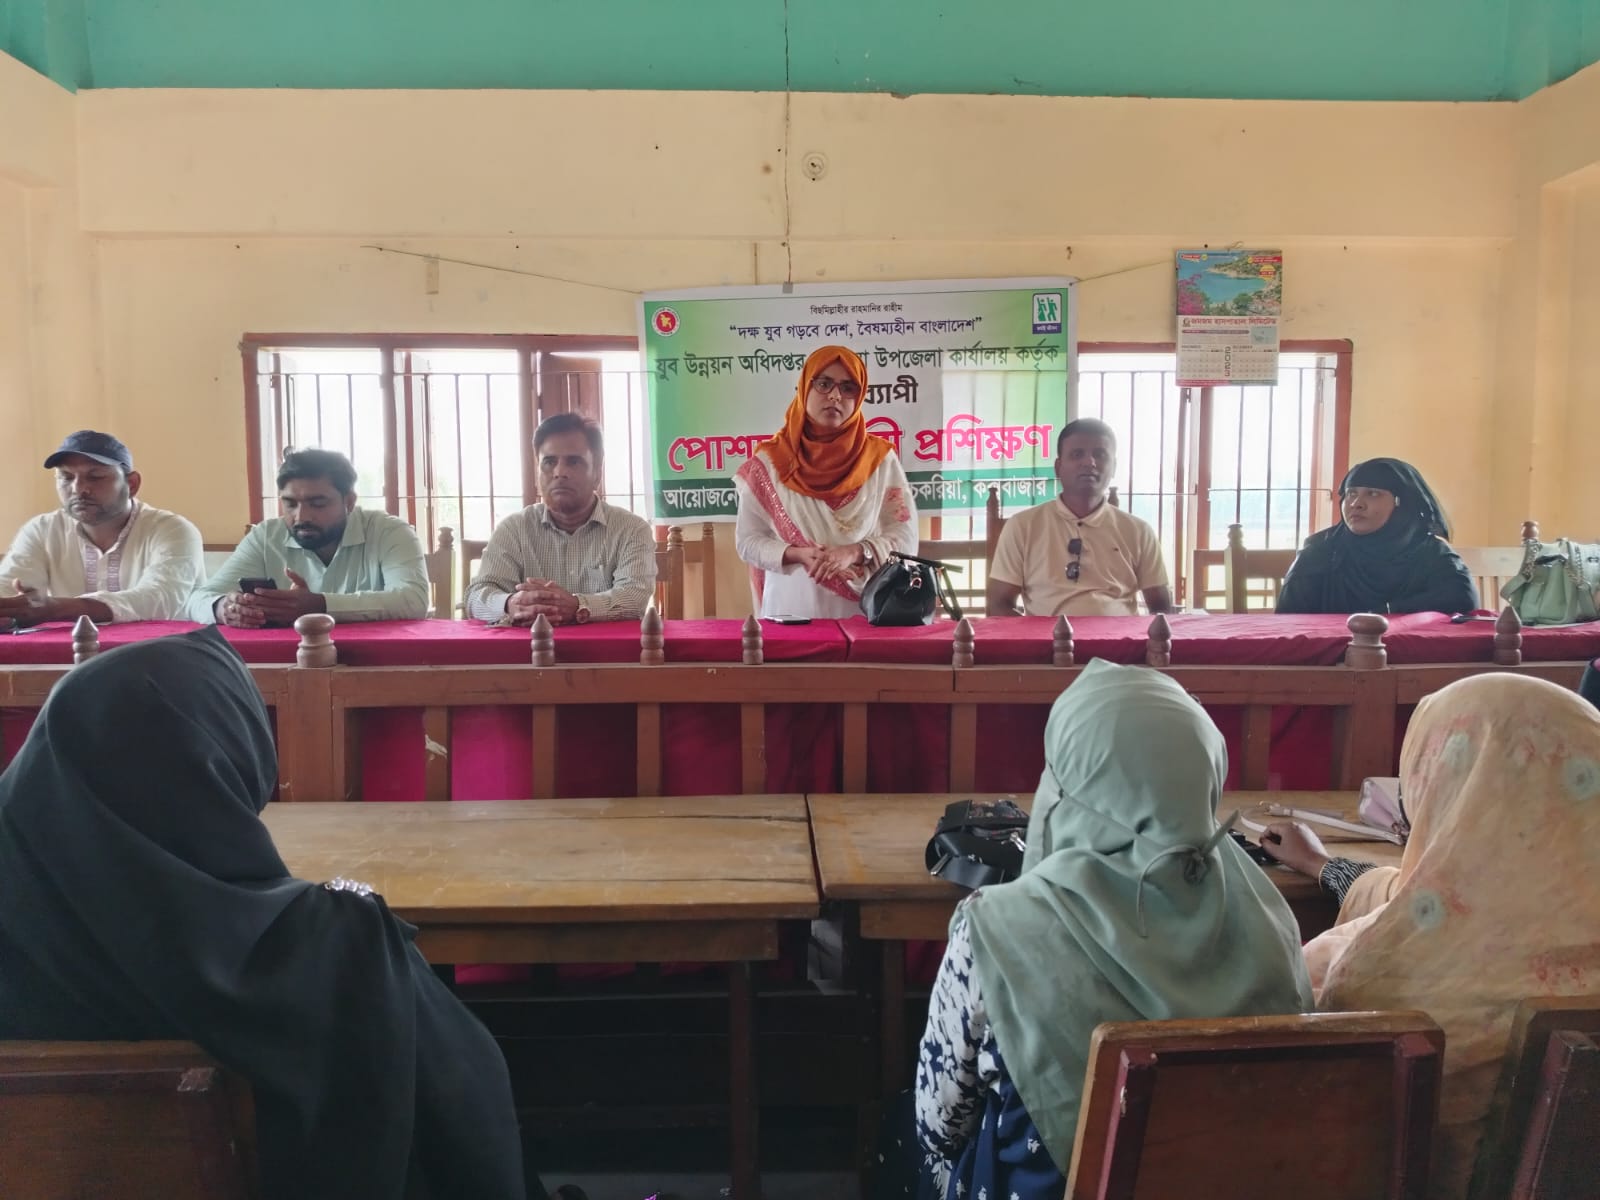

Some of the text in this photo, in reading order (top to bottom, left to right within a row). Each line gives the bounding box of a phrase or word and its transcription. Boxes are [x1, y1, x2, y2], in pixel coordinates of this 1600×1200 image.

[764, 325, 783, 342] যুব
[786, 324, 820, 341] গড়বে
[824, 321, 853, 339] দেশ,
[857, 317, 916, 336] বৈষম্যহীন
[919, 316, 982, 334] বাংলাদেশ”
[654, 357, 680, 380] যুব
[683, 352, 734, 379] উন্নয়ন
[737, 348, 806, 375] অধিদপ্তর
[874, 345, 943, 368] উপজেলা
[947, 340, 1010, 366] কার্যালয়
[1013, 338, 1060, 372] কর্তৃক
[913, 413, 1053, 462] প্রশিক্ষণ
